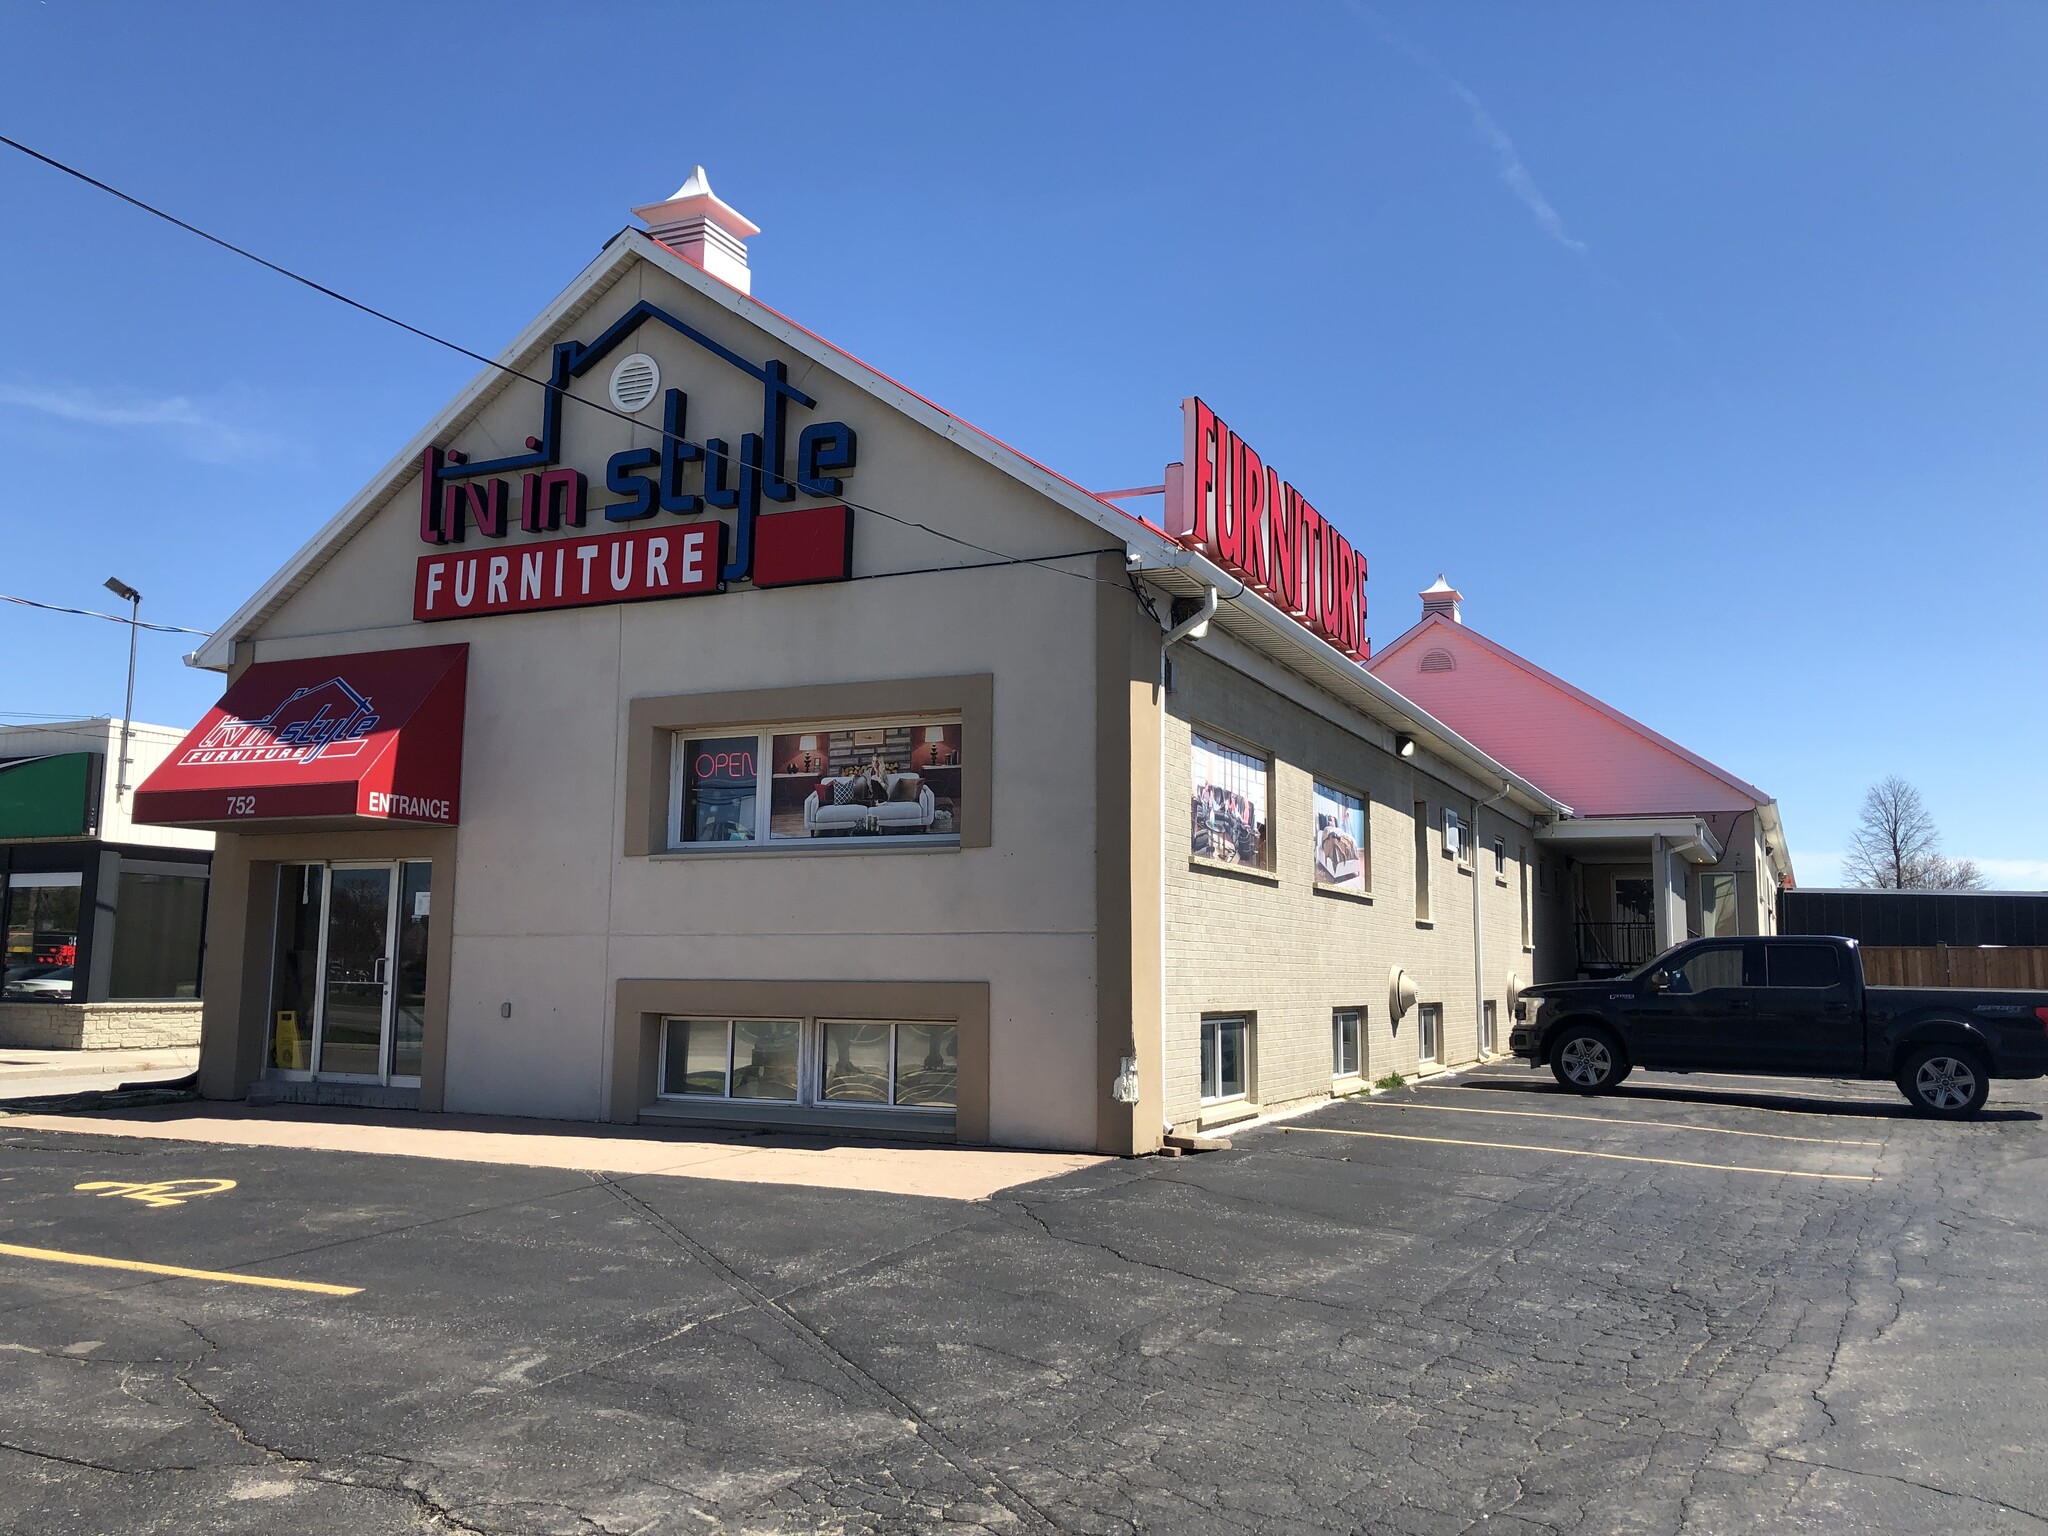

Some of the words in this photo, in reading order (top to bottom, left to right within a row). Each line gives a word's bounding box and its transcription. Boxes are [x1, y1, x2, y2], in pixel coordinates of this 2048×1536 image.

[1194, 396, 1371, 661] FURNITURE
[426, 532, 704, 611] FURNITURE
[188, 746, 308, 763] FURNITURE
[695, 752, 757, 778] OPEN
[227, 795, 256, 815] 752
[368, 791, 450, 819] ENTRANCE
